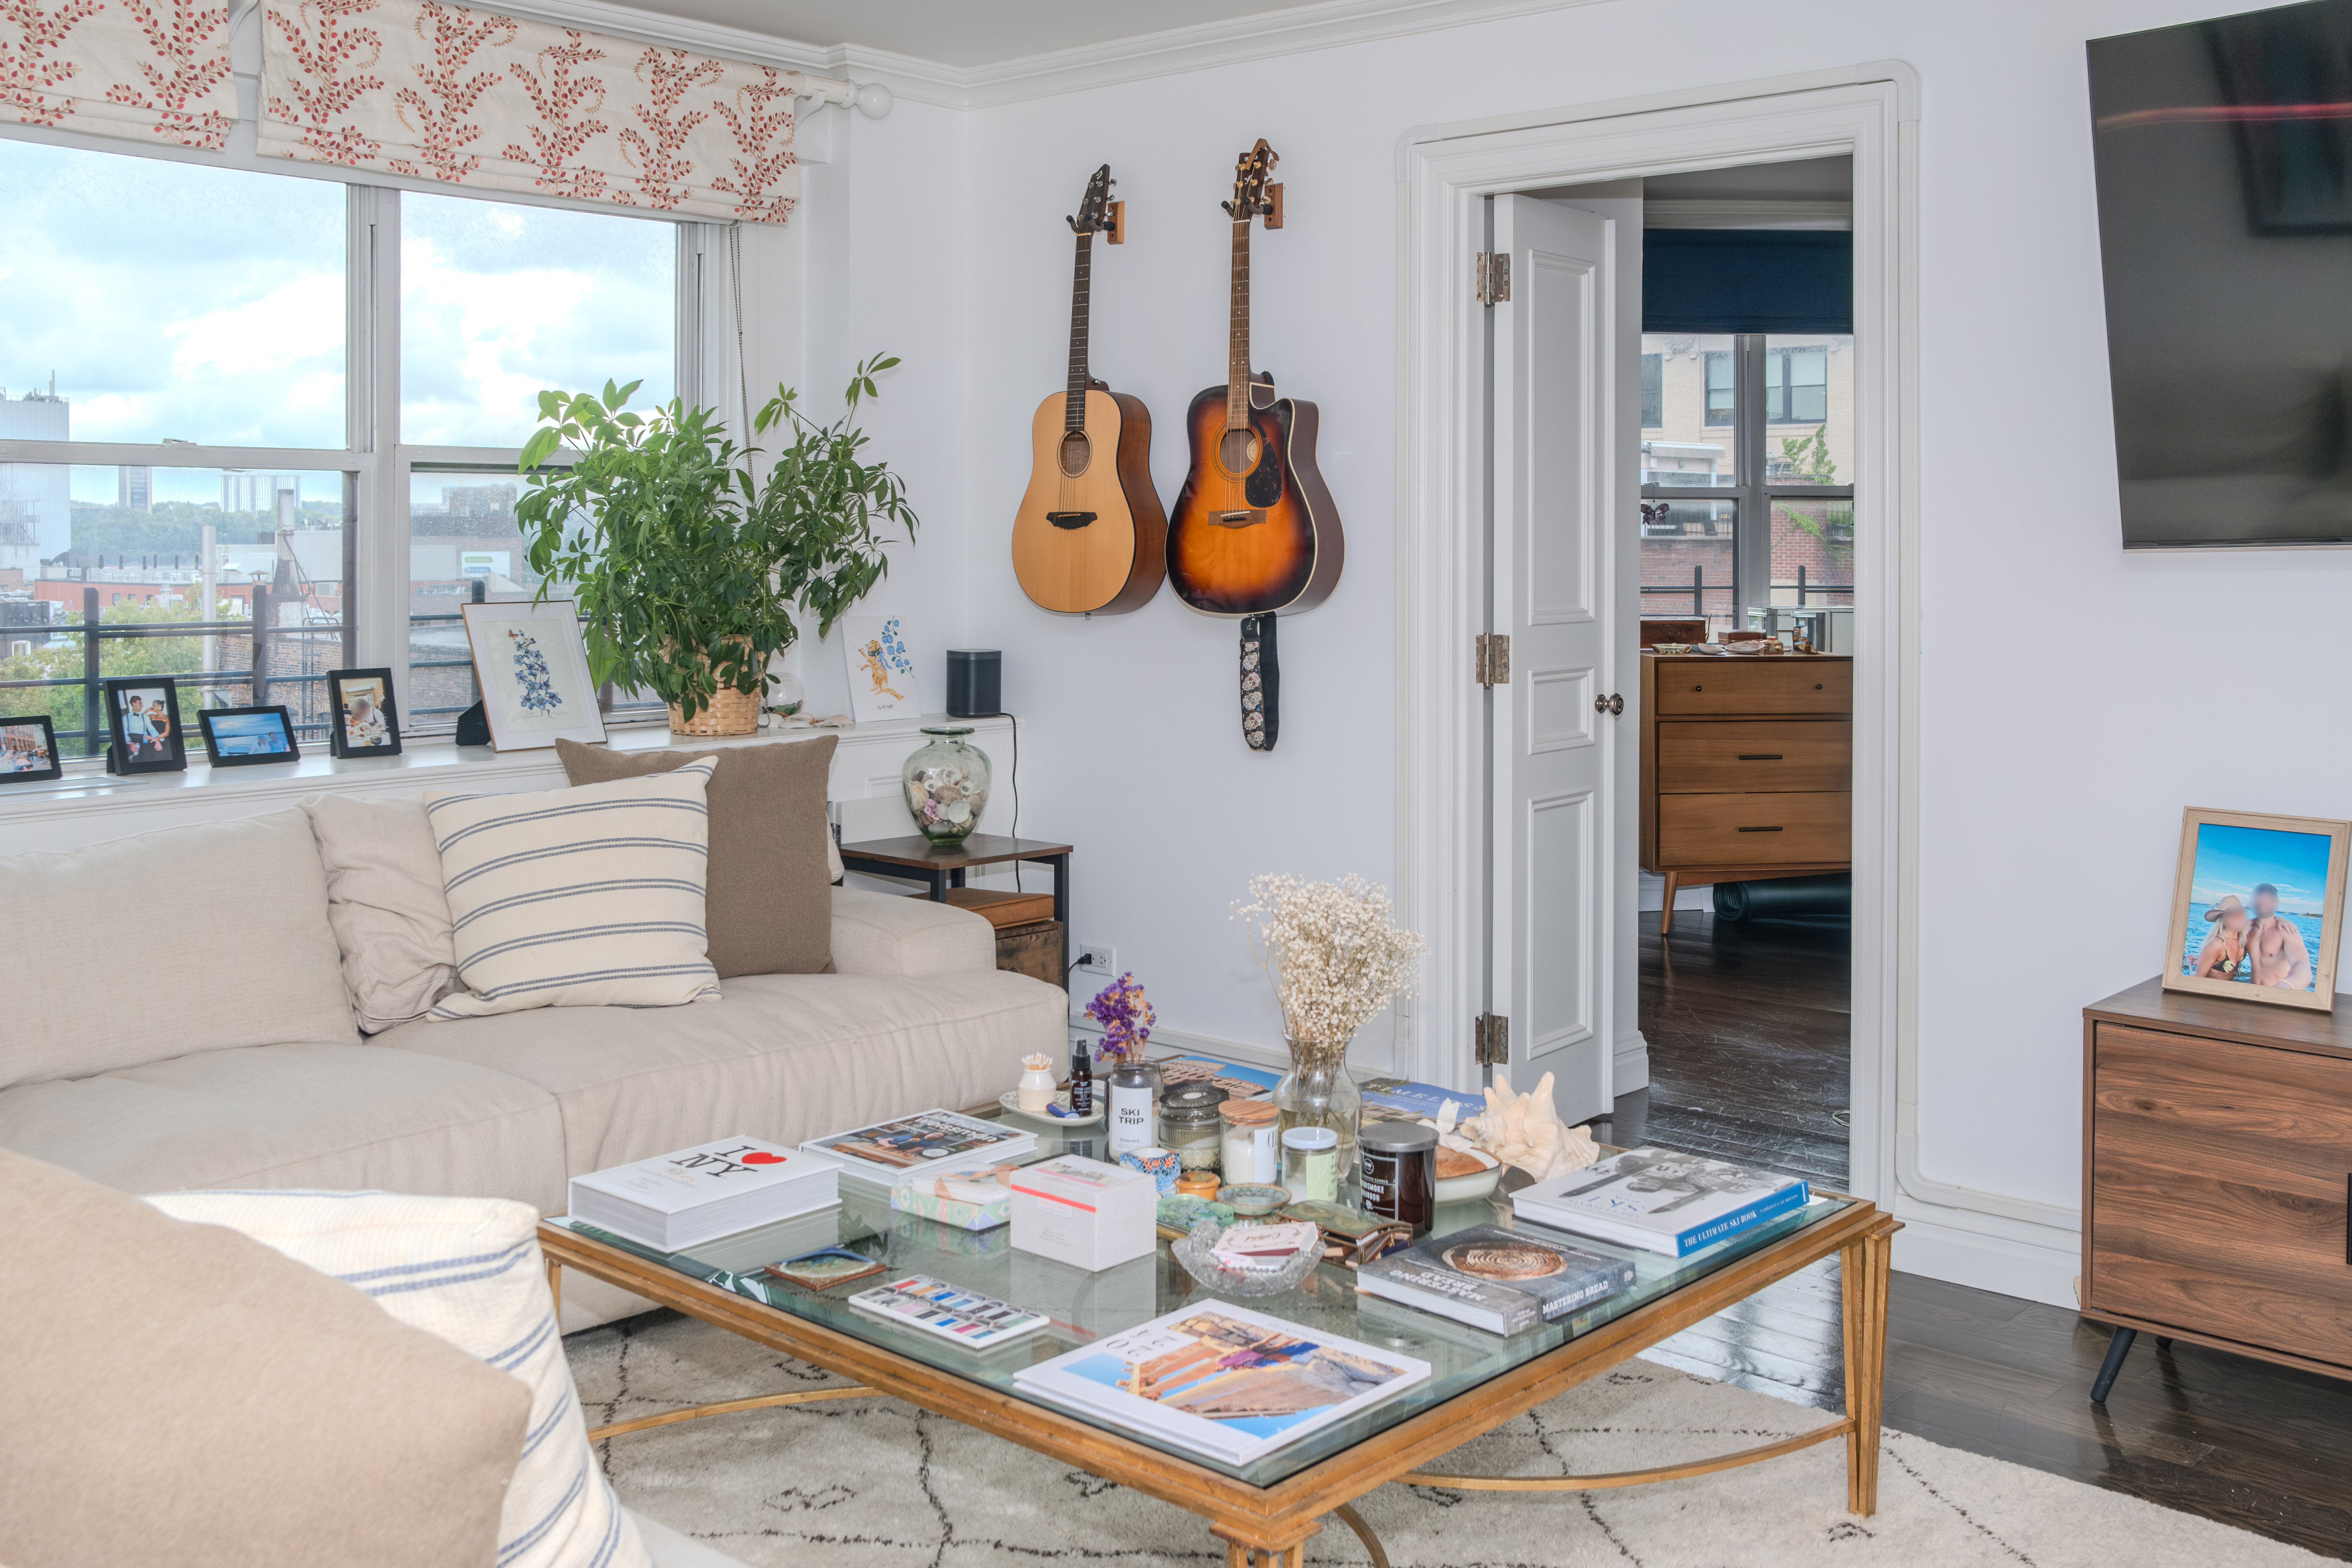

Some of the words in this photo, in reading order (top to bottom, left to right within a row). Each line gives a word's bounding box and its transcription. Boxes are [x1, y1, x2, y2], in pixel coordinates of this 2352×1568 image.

[914, 1116, 998, 1142] weissman
[1118, 1116, 1144, 1124] TRIP
[713, 1145, 758, 1157] I
[668, 1153, 759, 1177] NY
[1684, 1237, 1697, 1248] THE
[1698, 1222, 1729, 1242] ULTIMATE
[1729, 1217, 1740, 1228] SKI
[1741, 1210, 1757, 1223] BOOK
[1389, 1270, 1487, 1301] MASTERING
[1420, 1272, 1478, 1291] BREAD
[1542, 1290, 1584, 1315] MASTERING
[1585, 1280, 1609, 1297] BREAD
